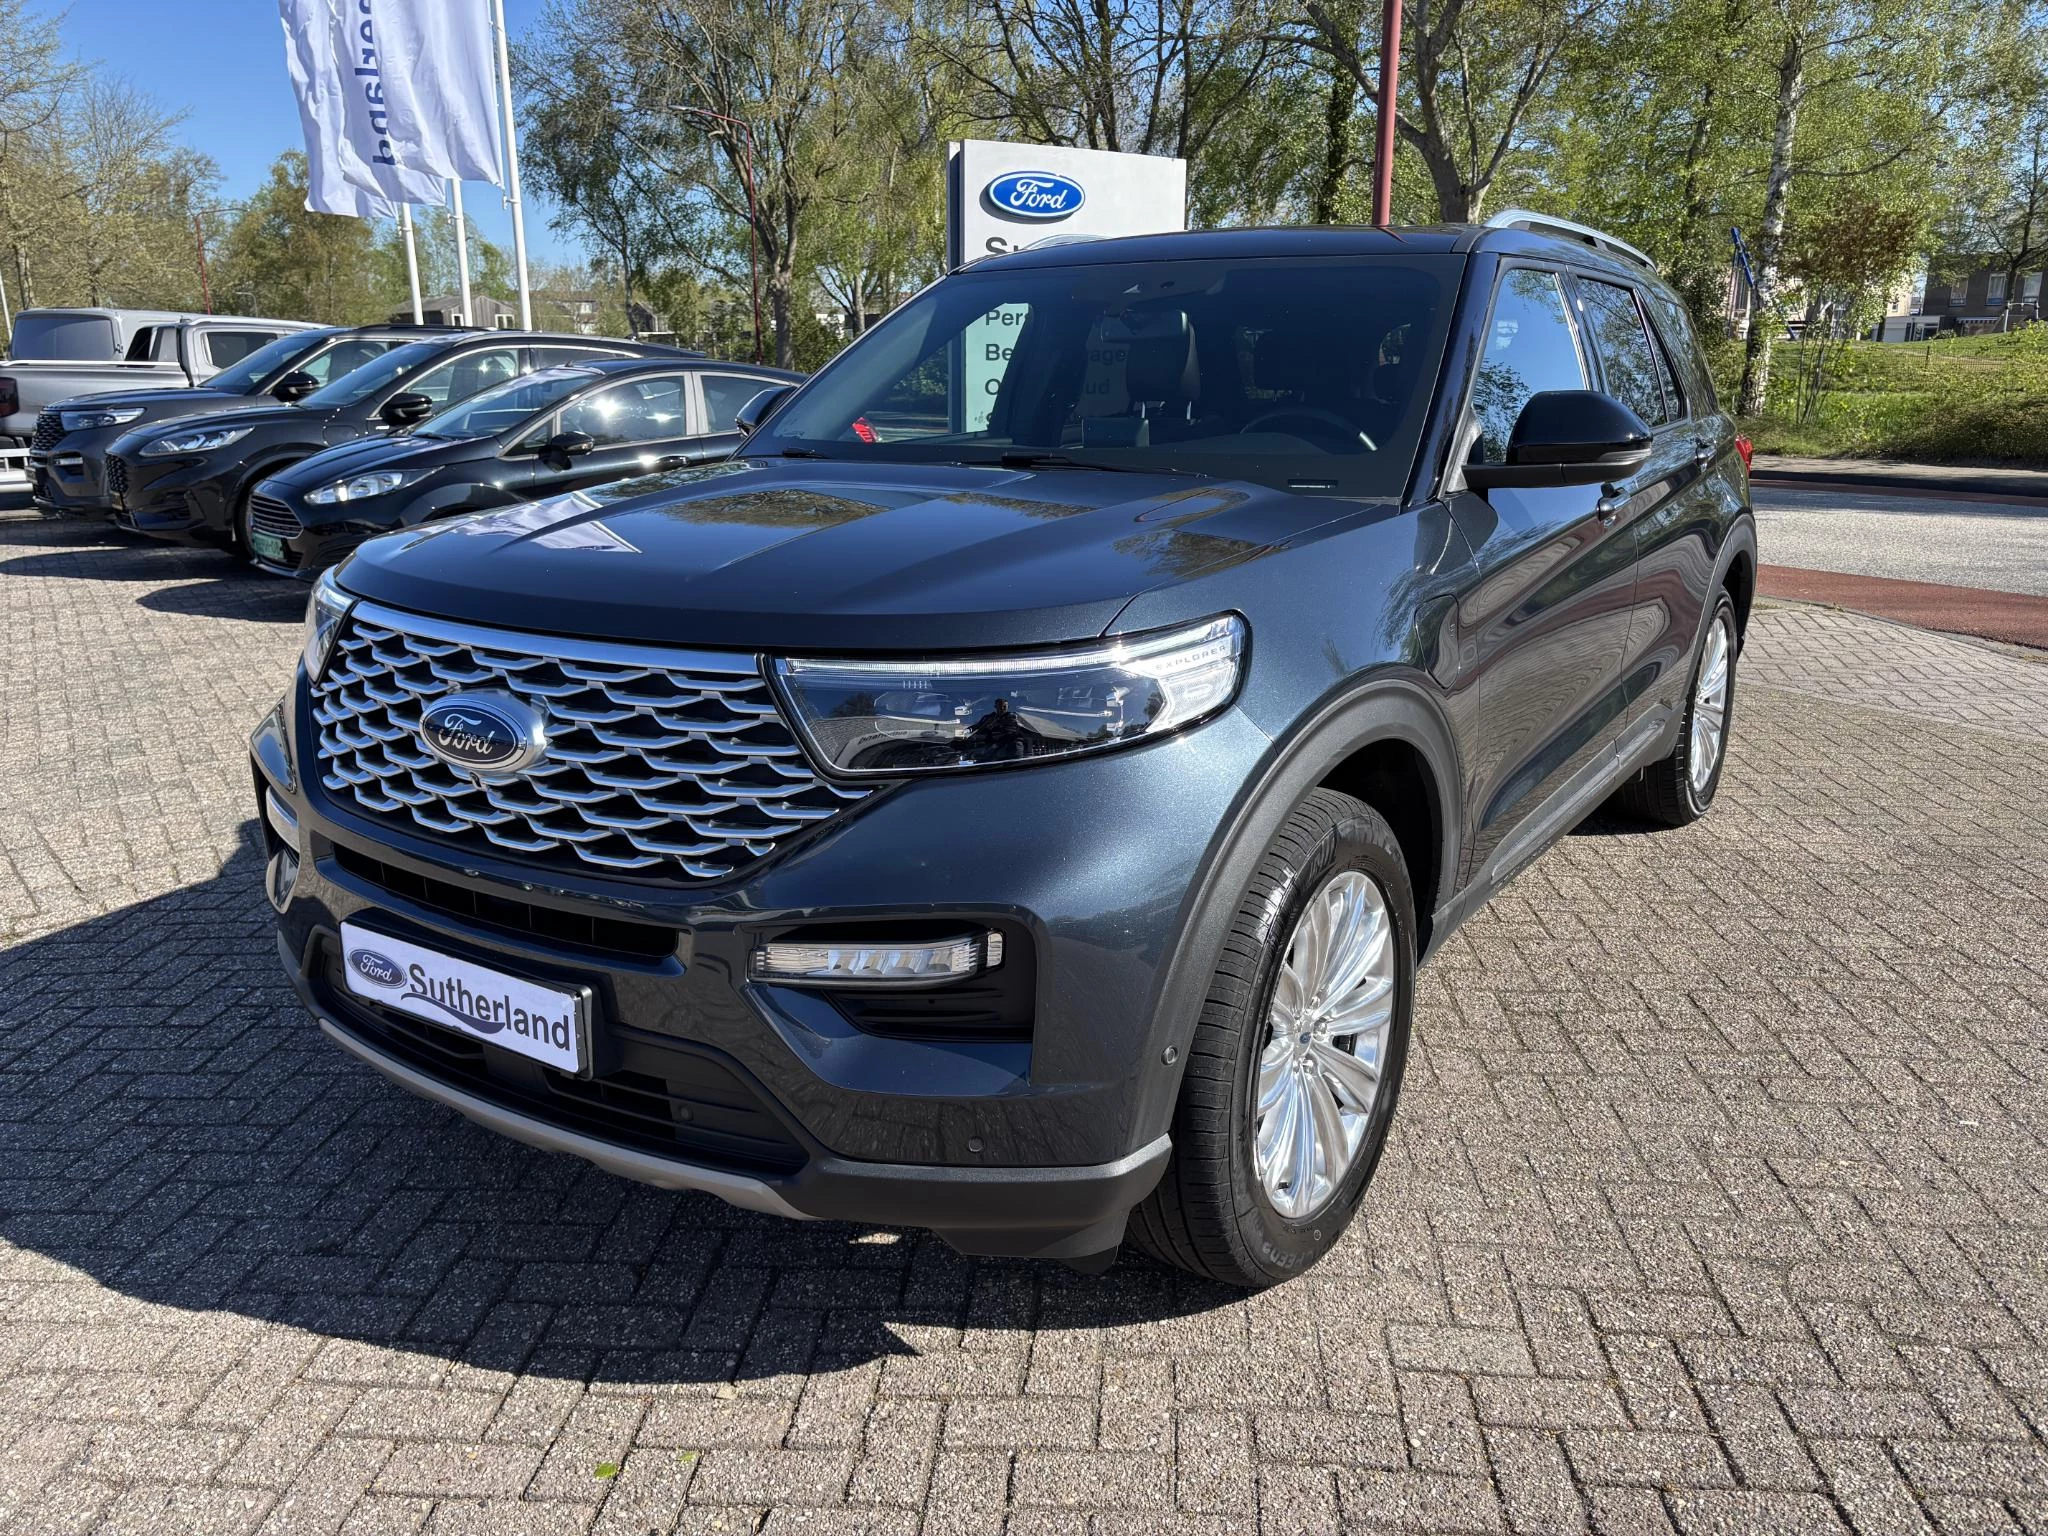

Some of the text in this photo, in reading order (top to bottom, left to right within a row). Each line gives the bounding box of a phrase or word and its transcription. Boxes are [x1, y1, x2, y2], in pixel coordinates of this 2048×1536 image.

[1009, 178, 1069, 210] Ford
[1155, 644, 1226, 671] EXPLORER
[438, 712, 493, 756] Ford
[359, 954, 571, 1051] Ford Sutherland
